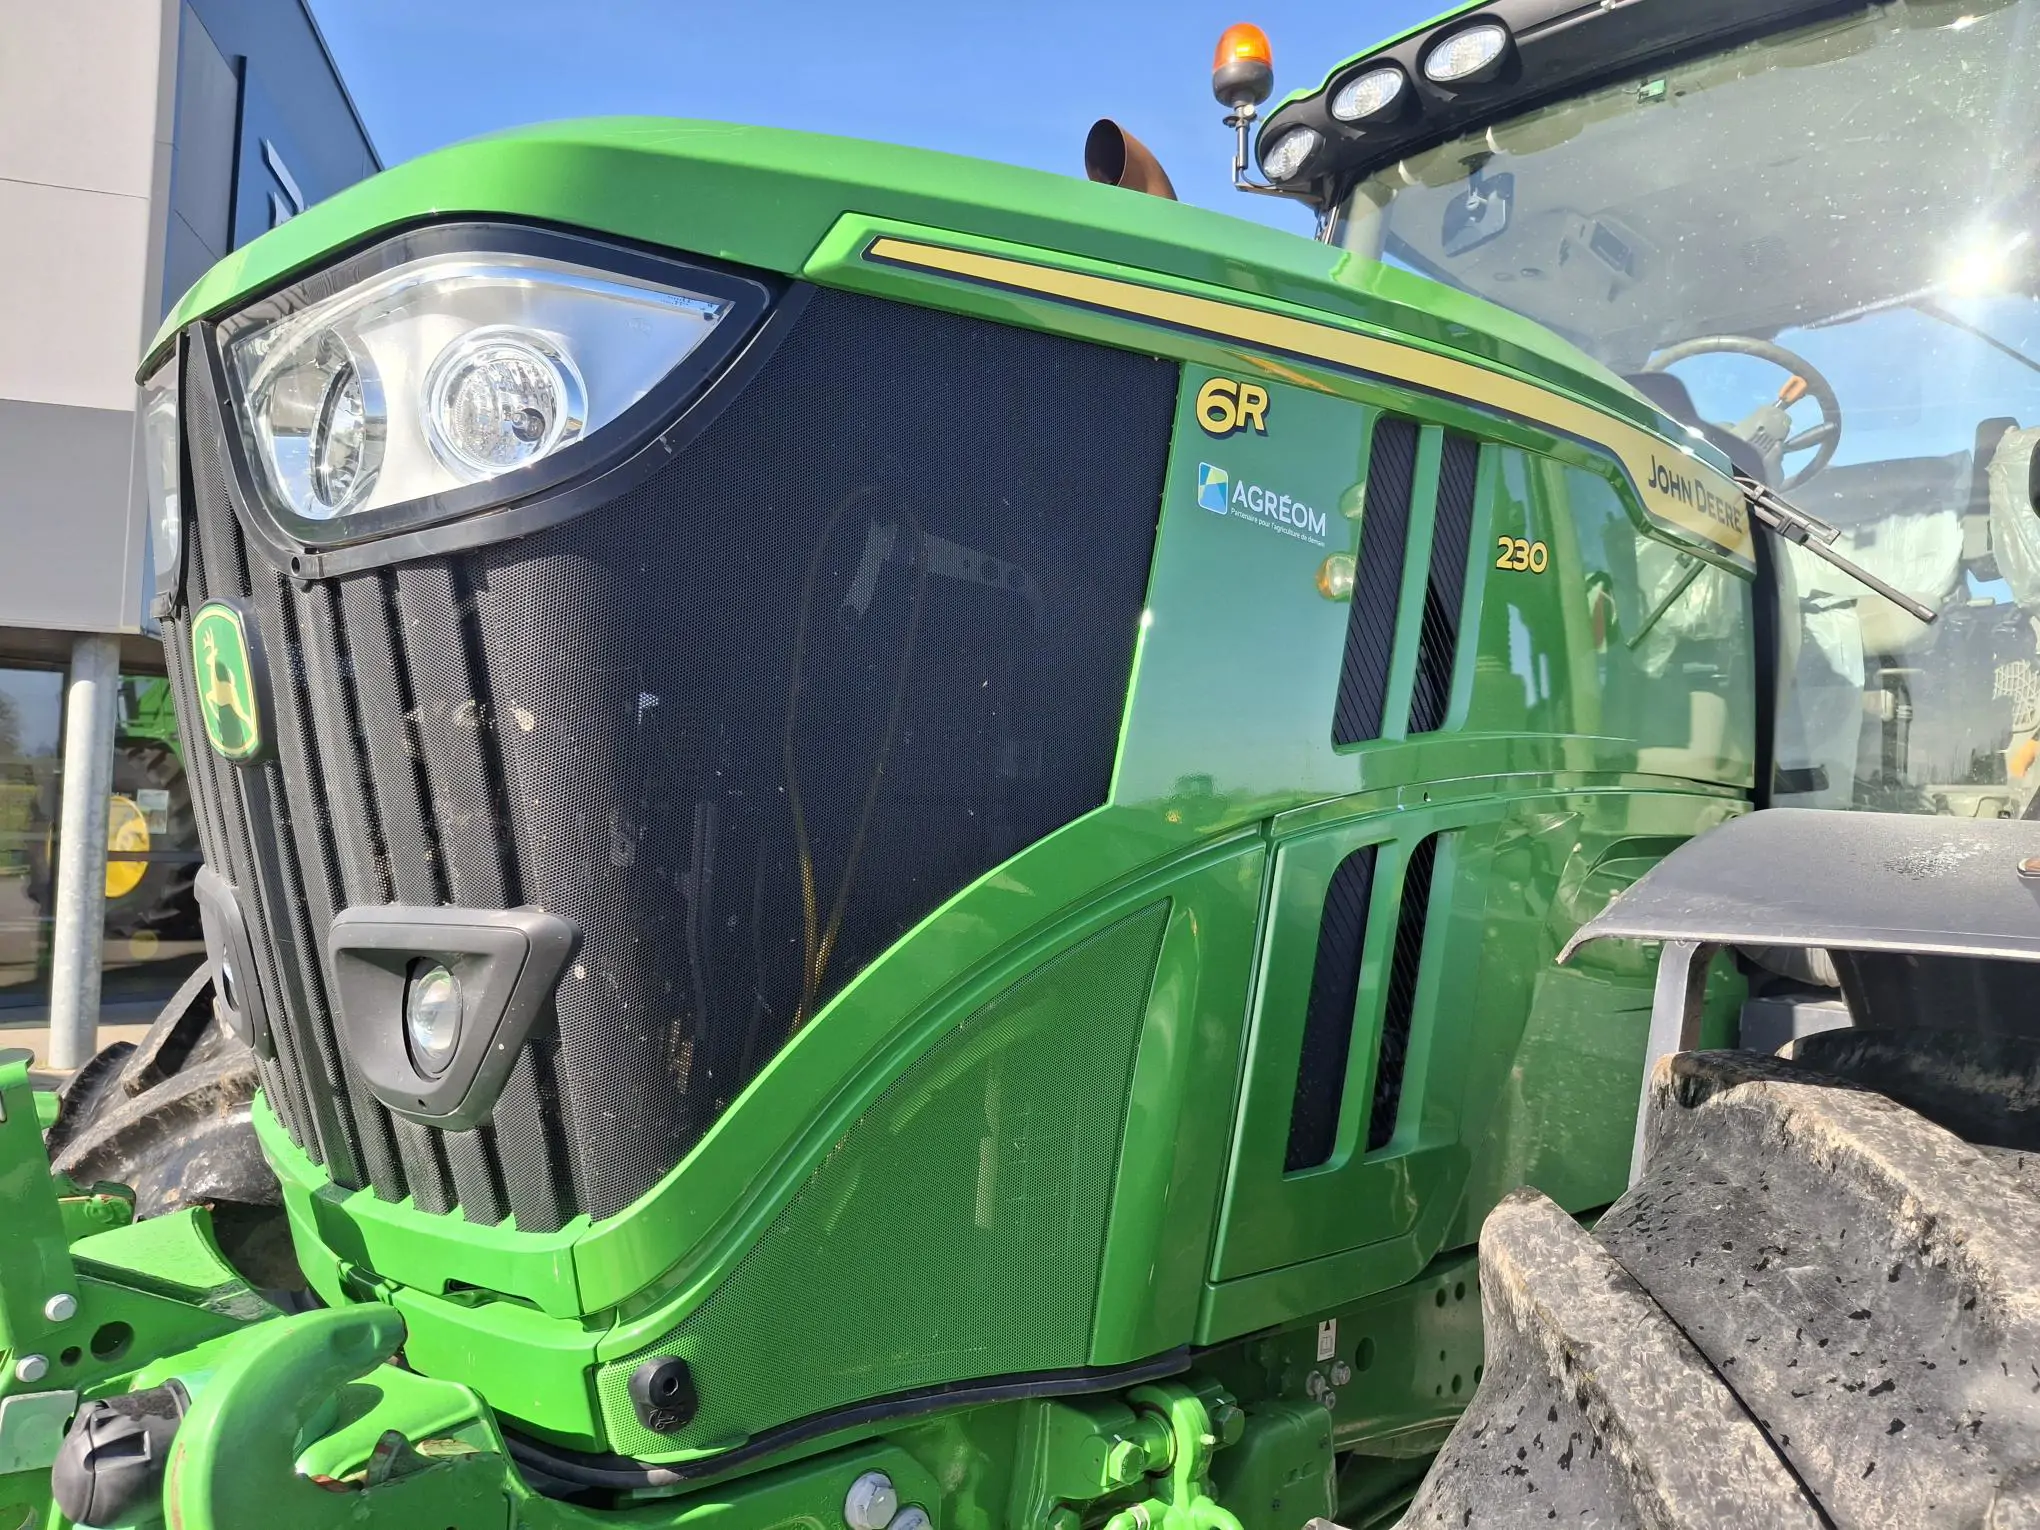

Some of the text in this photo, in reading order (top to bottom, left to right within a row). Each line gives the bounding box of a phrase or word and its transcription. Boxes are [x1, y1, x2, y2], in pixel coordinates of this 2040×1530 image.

[1196, 376, 1270, 440] 6R
[1232, 480, 1326, 537] AGRÉOM
[1648, 454, 1743, 534] JOHN DEERE
[1496, 535, 1548, 574] 230
